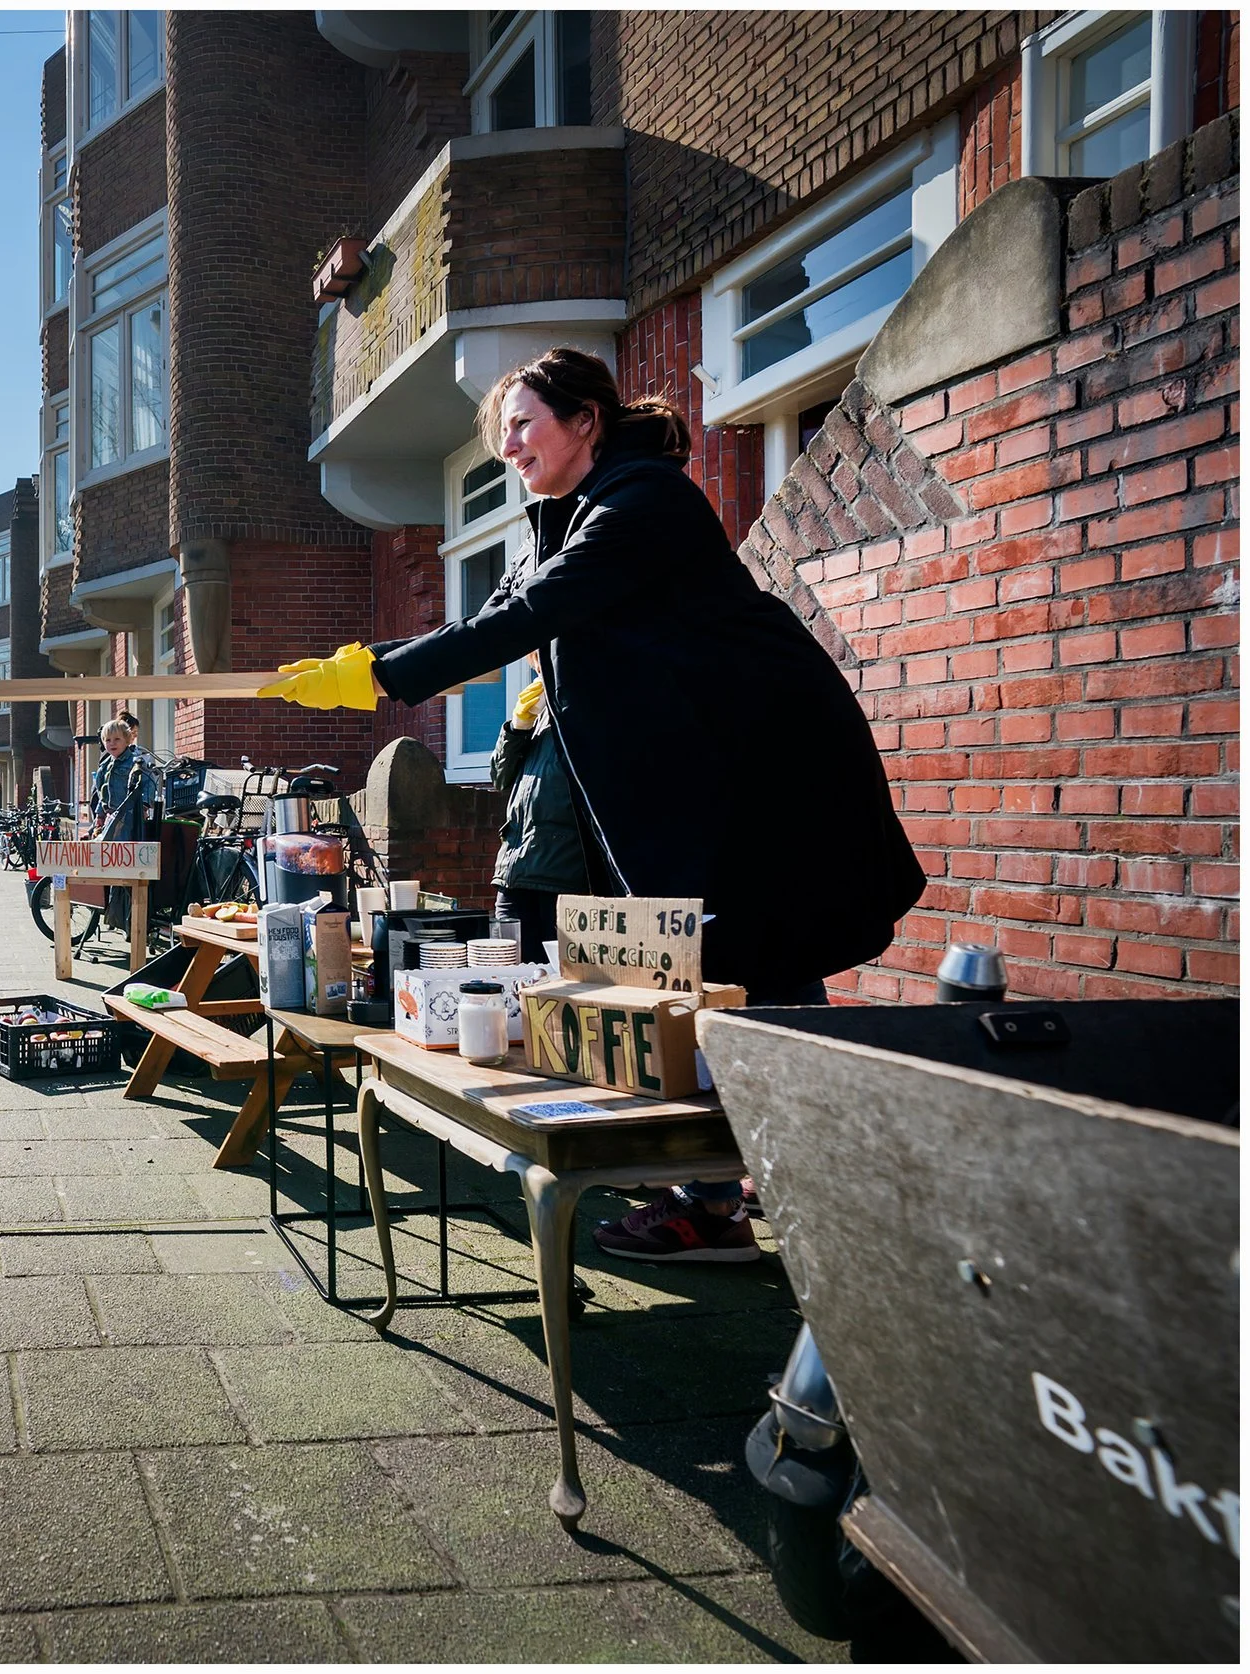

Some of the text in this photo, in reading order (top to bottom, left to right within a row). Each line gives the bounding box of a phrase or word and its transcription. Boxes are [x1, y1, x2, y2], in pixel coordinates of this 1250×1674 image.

[38, 841, 95, 868] VITAMiNE
[100, 841, 139, 868] BOOST
[282, 926, 299, 934] FOOD
[564, 904, 697, 939] KOFFiE 1,50
[566, 941, 673, 971] CAPPUCCiNO
[525, 996, 662, 1092] KOFFiE
